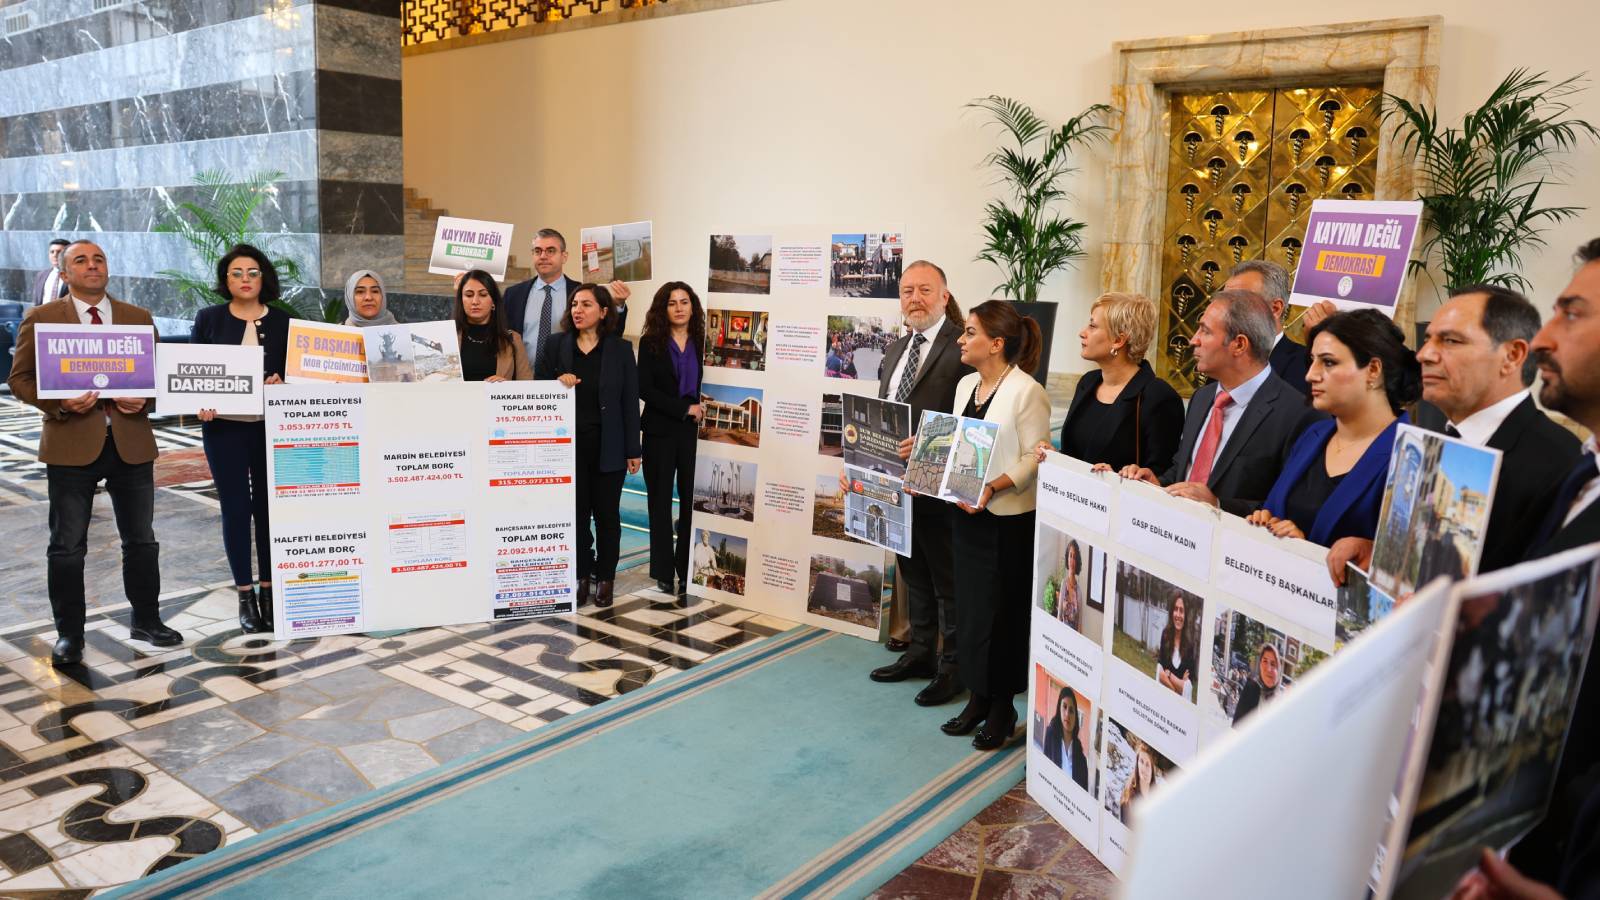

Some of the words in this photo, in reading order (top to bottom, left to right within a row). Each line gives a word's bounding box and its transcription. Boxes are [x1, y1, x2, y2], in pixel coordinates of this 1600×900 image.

[441, 228, 477, 244] KAYYIM
[477, 230, 503, 247] DEĞİL
[1312, 221, 1364, 246] KAYYIM
[1363, 218, 1402, 250] DEĞİL
[1322, 254, 1378, 275] DEMOKRASİ
[47, 338, 103, 355] KAYYIM
[107, 335, 145, 355] DEĞİL
[296, 334, 310, 353] EŞ
[69, 359, 127, 372] DEMOKRASİ
[303, 357, 321, 368] MOR
[180, 364, 223, 375] KAYYIM
[170, 375, 250, 393] DARBEDİR
[268, 398, 307, 406] BATMAN
[309, 396, 362, 405] BELEDİYESİ
[526, 392, 568, 400] BELEDİYESİ
[536, 404, 557, 412] BORÇ
[323, 410, 348, 418] BORÇ
[383, 452, 416, 461] MARDİN
[418, 450, 466, 459] BELEDİYESİ
[431, 462, 454, 470] BORÇ
[1042, 481, 1059, 494] SEÇME
[1066, 491, 1089, 506] SEÇİLME
[1089, 500, 1108, 513] HAKKI
[536, 522, 572, 530] BELEDİYESİ
[274, 534, 312, 543] HALFETİ
[314, 531, 367, 541] BELEDİYESİ
[501, 534, 538, 543] TOPLAM
[540, 532, 565, 541] BORÇ
[1131, 517, 1149, 530] GASP
[1149, 524, 1173, 540] EDİLEN
[1174, 534, 1197, 550] KADIN
[285, 547, 326, 556] TOPLAM
[328, 545, 356, 555] BORÇ
[497, 545, 556, 556] 22.092.914,41
[277, 557, 350, 569] 460.601.277,00
[351, 556, 364, 565] TL
[1224, 556, 1264, 580] BELEDİYE
[1265, 573, 1277, 586] EŞ
